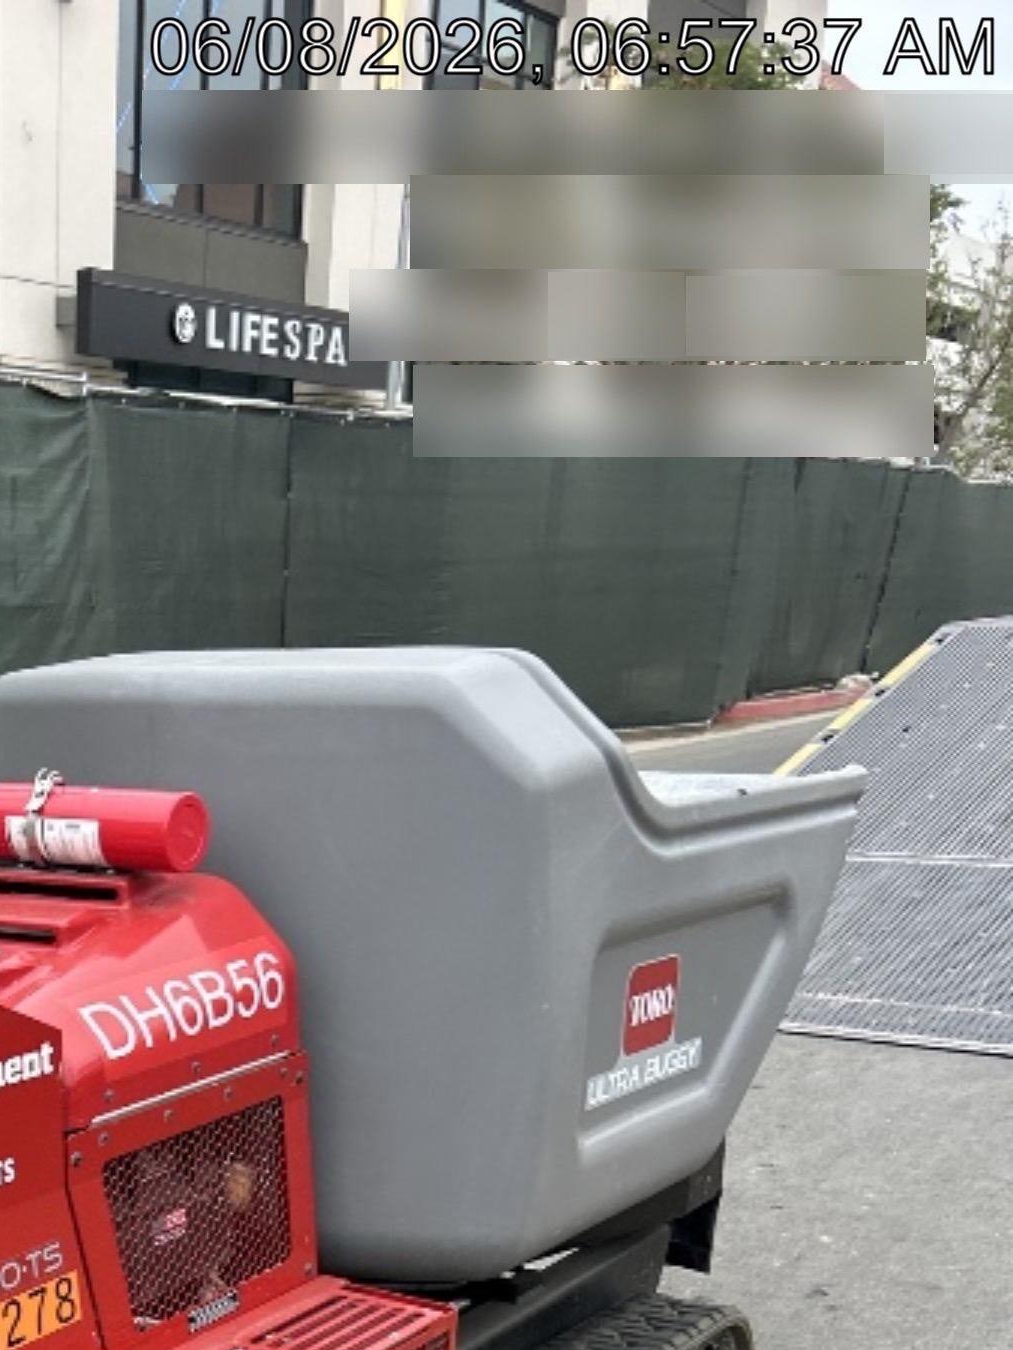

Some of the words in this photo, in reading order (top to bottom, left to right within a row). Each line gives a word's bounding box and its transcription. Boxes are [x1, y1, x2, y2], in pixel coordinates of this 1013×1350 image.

[205, 306, 347, 366] LIFESPA
[79, 953, 285, 1060] DH6B56
[629, 983, 676, 1027] TORO
[587, 1064, 640, 1107] ULTRA
[643, 1037, 702, 1085] BUGGY
